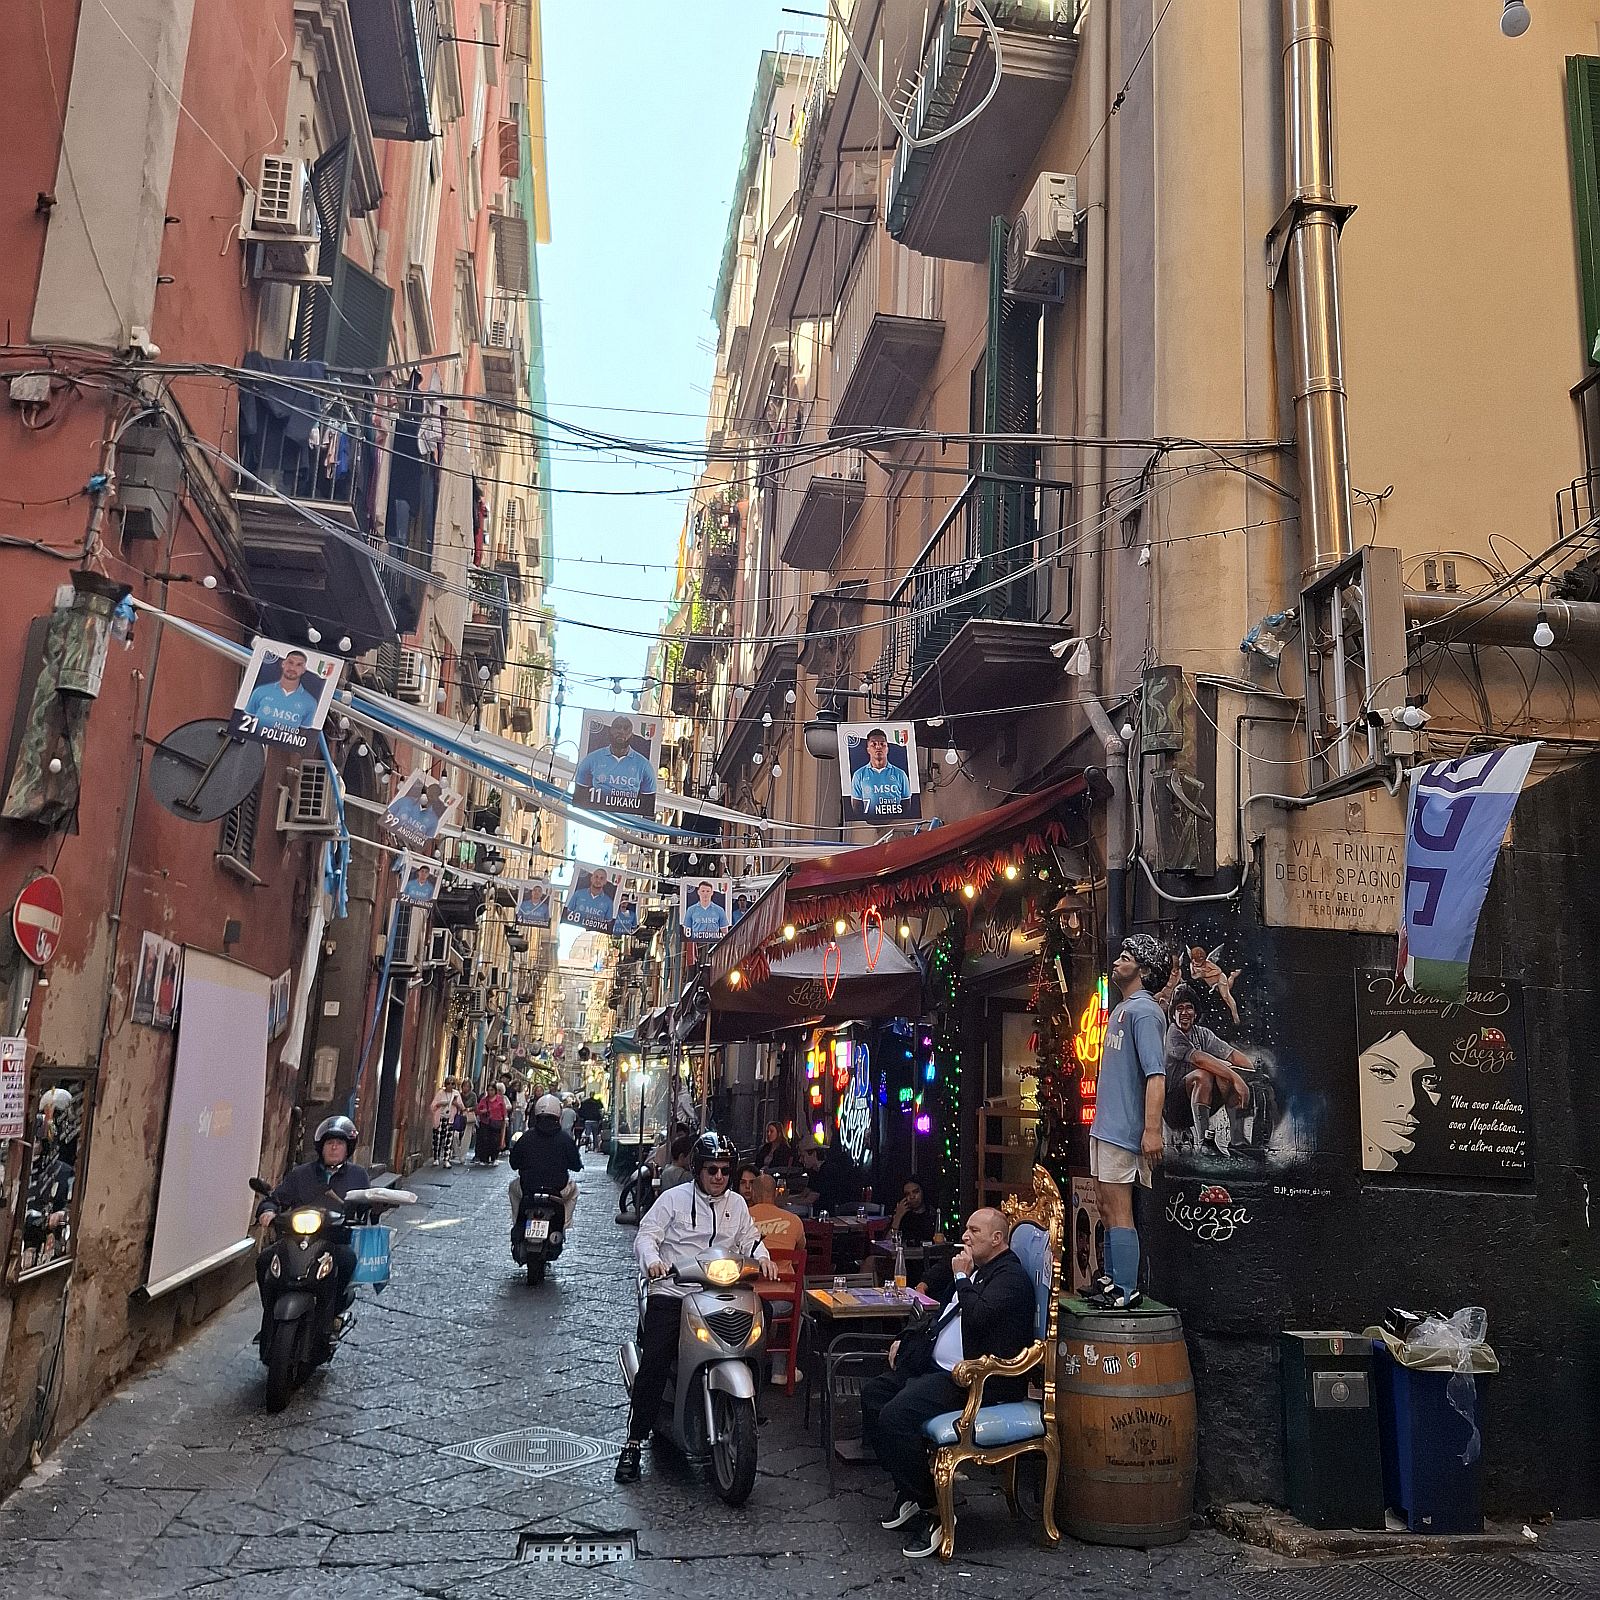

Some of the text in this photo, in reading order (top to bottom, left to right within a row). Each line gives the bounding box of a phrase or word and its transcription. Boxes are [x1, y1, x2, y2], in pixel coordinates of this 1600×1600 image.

[239, 715, 307, 747] 21 POLITANO
[608, 774, 635, 786] MSC
[589, 787, 640, 808] 11 LUKAKU
[610, 788, 638, 798] Romelu
[879, 796, 896, 804] David
[863, 798, 903, 814] 7 NERES
[385, 813, 400, 827] 99
[1292, 840, 1322, 859] VIA
[1275, 863, 1324, 884] DEGLI
[1337, 891, 1356, 903] DEL
[1308, 904, 1364, 918] FERDINANDO
[567, 910, 581, 923] 68
[581, 918, 608, 931] LOBOTKA
[684, 927, 692, 938] 8
[1450, 1033, 1517, 1073] Laezza
[1471, 1101, 1490, 1110] sono
[1448, 1121, 1467, 1130] sono
[1165, 1192, 1254, 1241] Laezza
[1110, 1411, 1135, 1432] JACK
